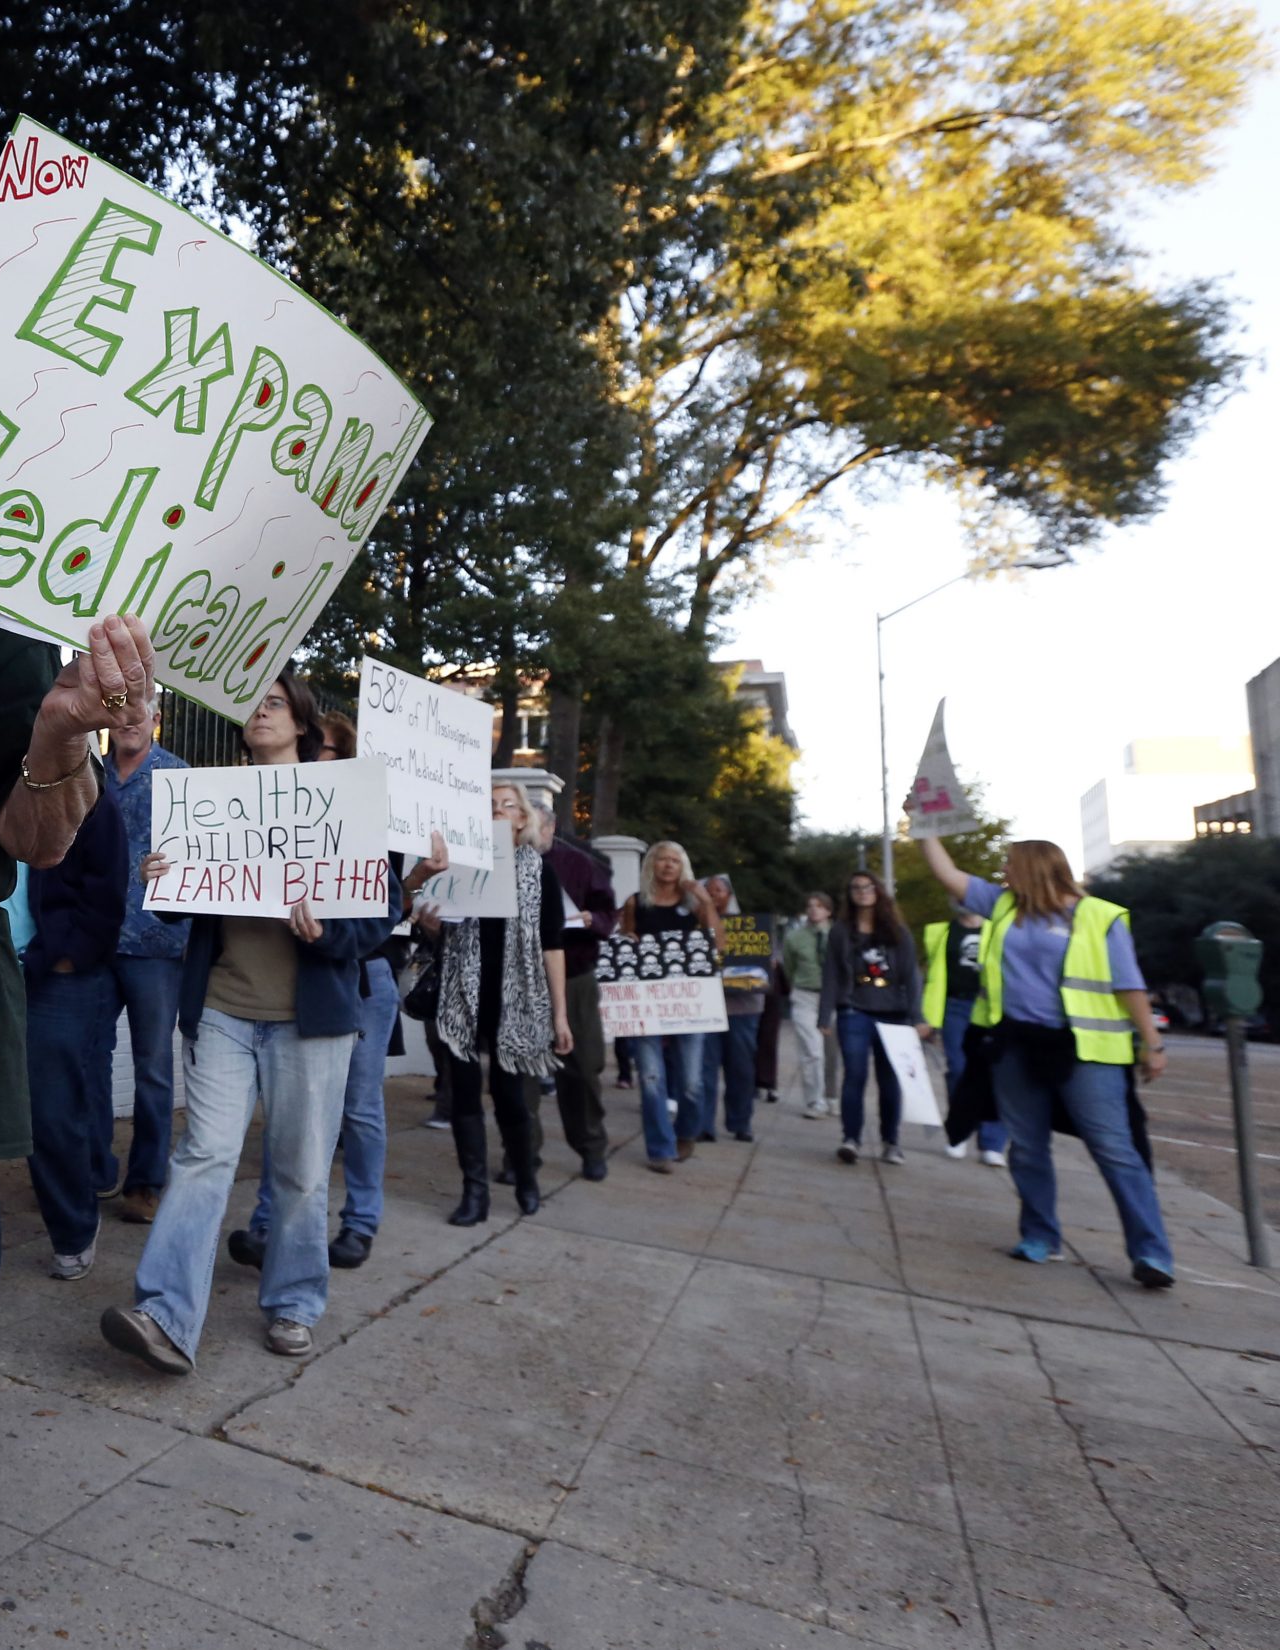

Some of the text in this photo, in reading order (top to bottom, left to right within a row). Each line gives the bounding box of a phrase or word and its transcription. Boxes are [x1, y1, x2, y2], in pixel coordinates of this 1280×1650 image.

[16, 197, 431, 541] Expand
[368, 666, 408, 714] 58%
[409, 702, 422, 727] of
[408, 748, 444, 785] Medicaid
[162, 768, 335, 835] Healthy
[416, 801, 425, 838] Is
[440, 808, 466, 847] Human
[157, 819, 343, 866] CHILDREN
[149, 863, 263, 903] LEARN
